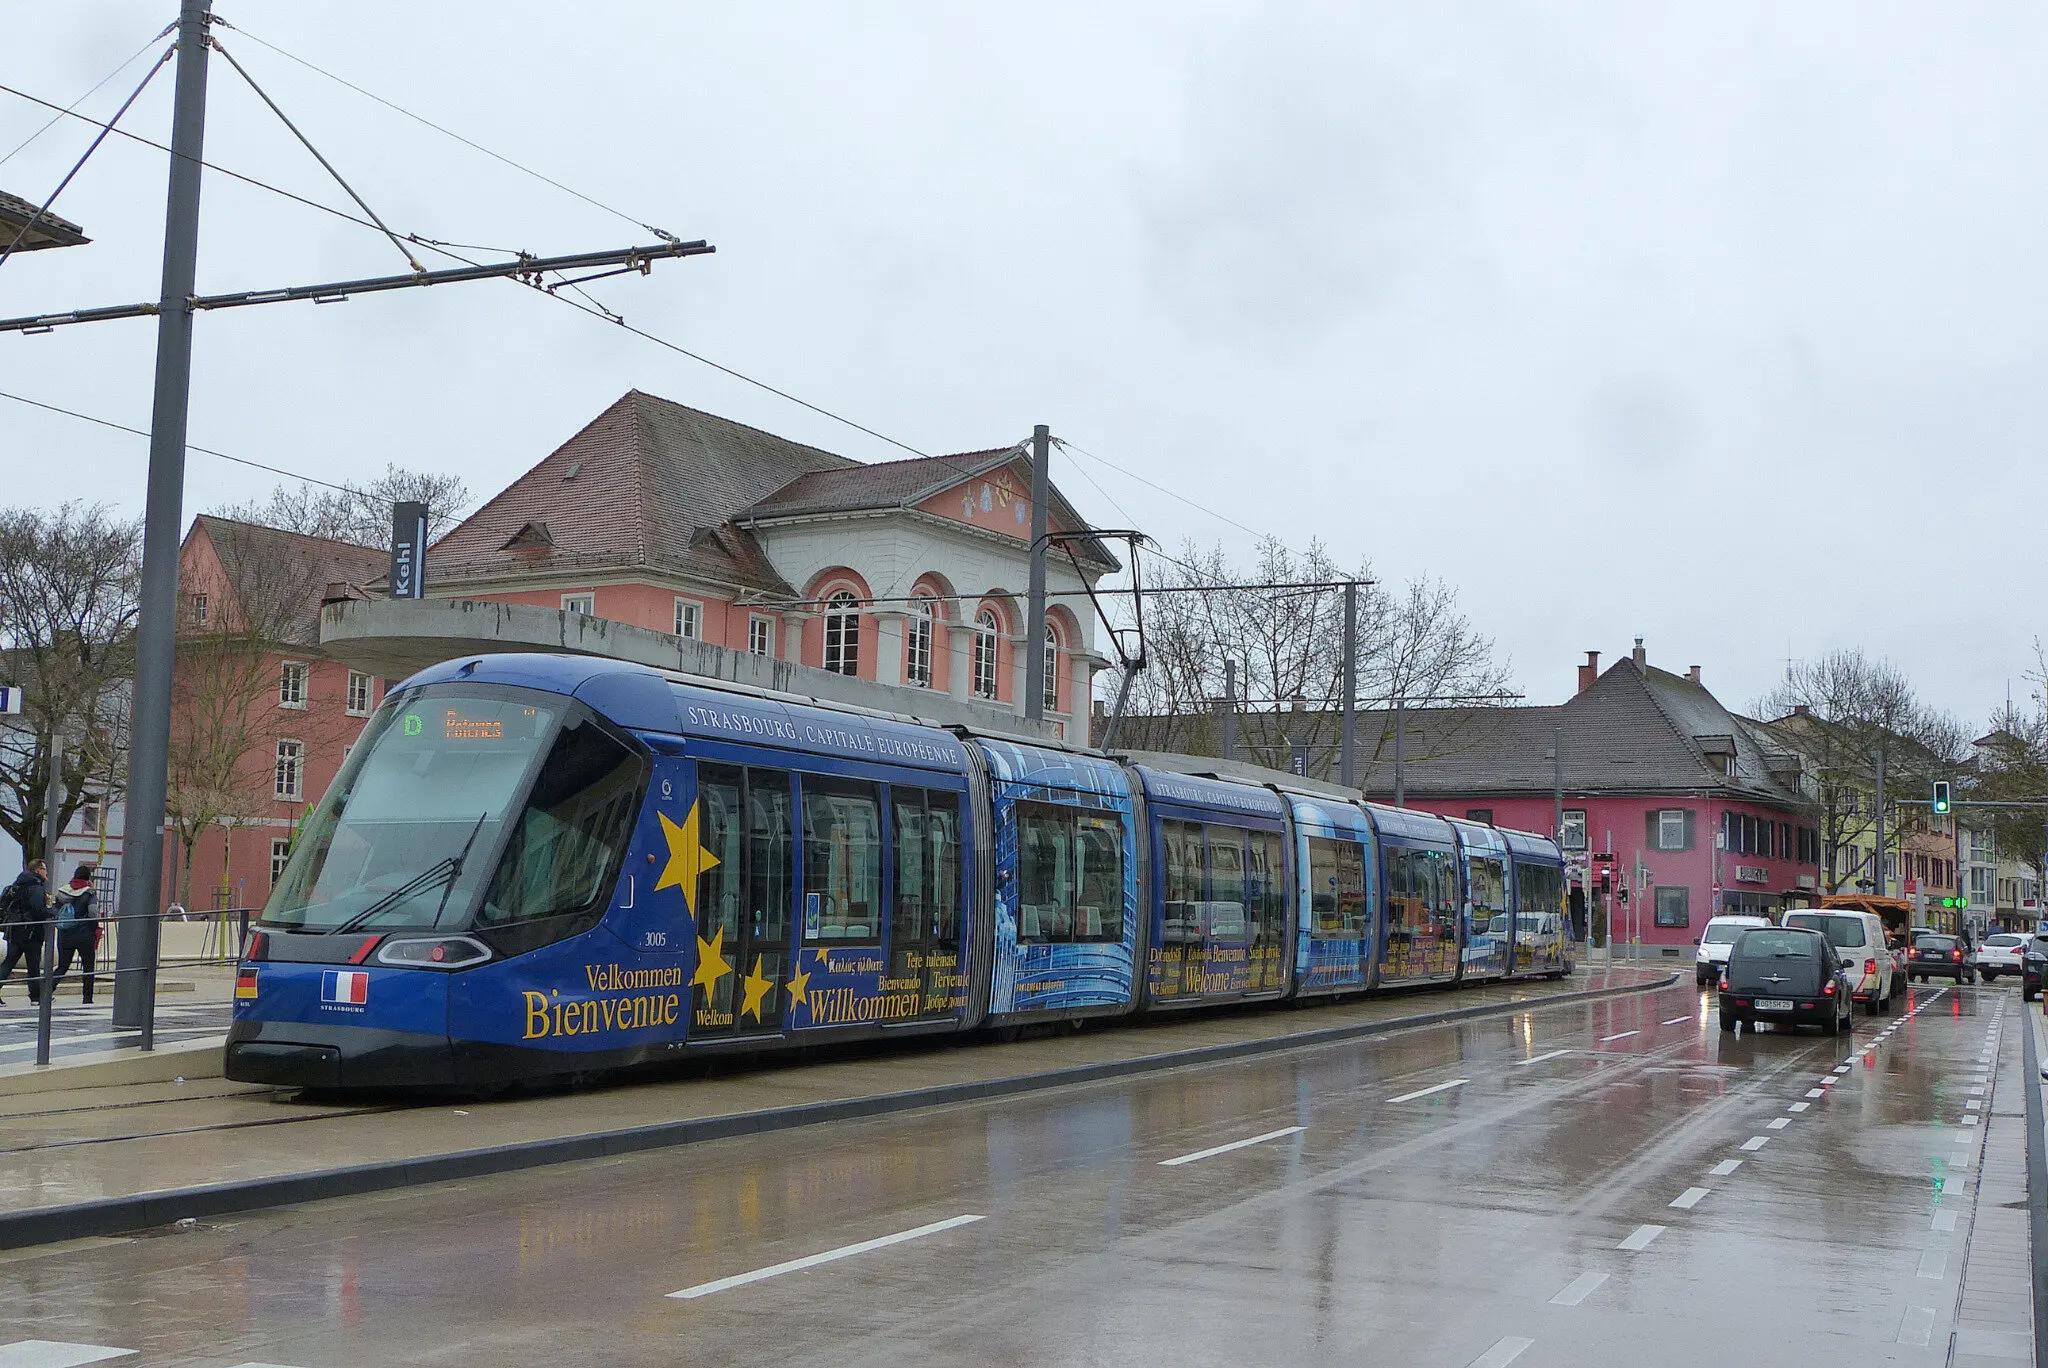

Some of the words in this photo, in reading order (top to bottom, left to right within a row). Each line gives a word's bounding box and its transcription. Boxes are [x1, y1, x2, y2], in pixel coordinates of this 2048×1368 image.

[395, 542, 411, 595] Kehl
[404, 714, 422, 736] D
[687, 705, 803, 744] STRASBOURG,
[805, 725, 875, 752] CAPITALE
[877, 739, 959, 765] EUROPÉENNE
[1294, 757, 1303, 776] ehl
[644, 931, 667, 947] 3005
[906, 952, 923, 969] Tere
[585, 963, 682, 992] Velkommen
[878, 974, 921, 992] Bienvenido
[1185, 966, 1231, 994] Welcome
[320, 1004, 364, 1014] STRASBOURG
[521, 988, 680, 1040] Bienvenue
[808, 987, 920, 1024] Willkommen
[695, 1008, 734, 1027] Welkom
